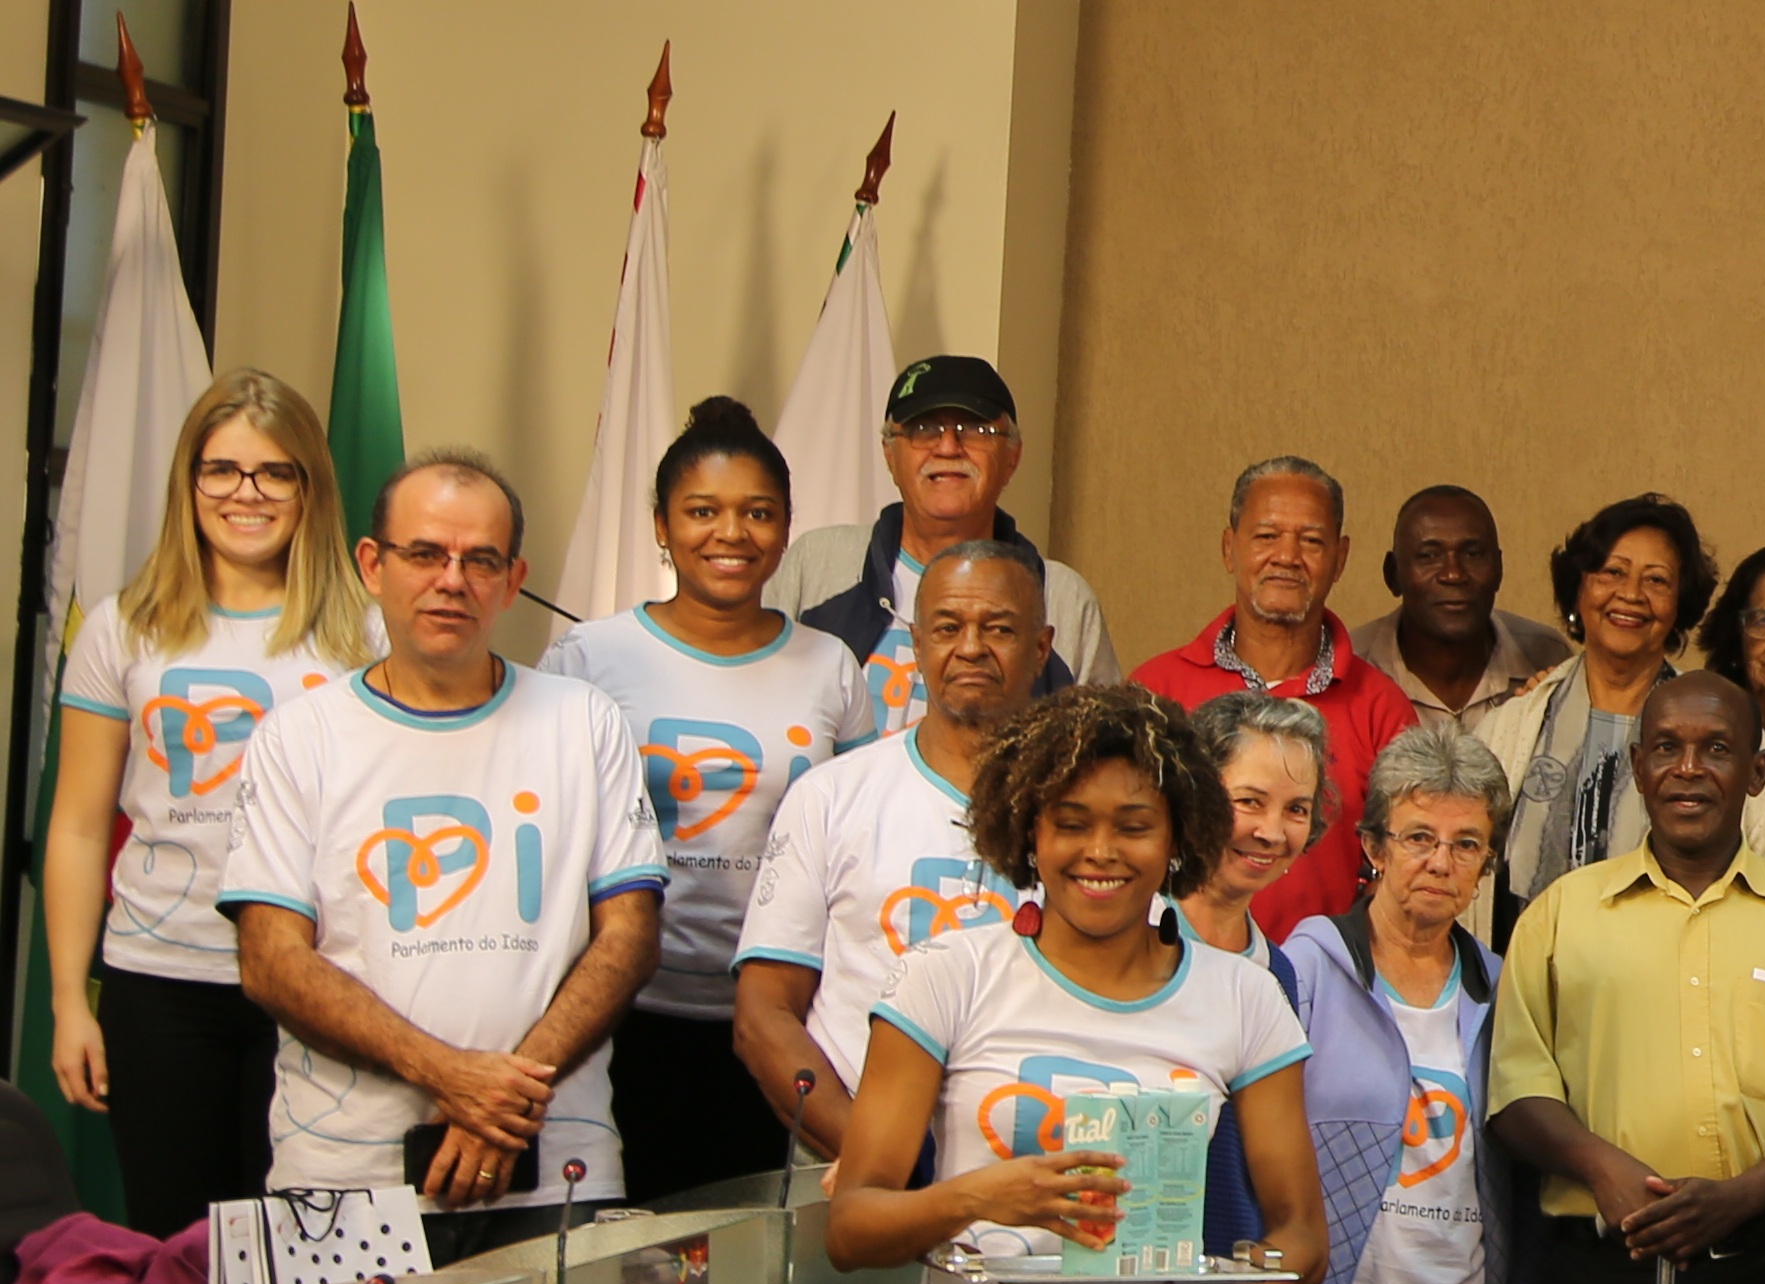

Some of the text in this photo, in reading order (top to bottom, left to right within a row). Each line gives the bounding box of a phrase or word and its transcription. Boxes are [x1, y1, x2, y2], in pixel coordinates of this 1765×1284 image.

[168, 808, 232, 824] Parlamen
[666, 851, 730, 870] rlamento
[735, 856, 751, 870] do
[391, 934, 540, 958] Parlamento do Idoso
[1065, 1107, 1117, 1145] Tial
[1381, 1199, 1450, 1221] arlamento
